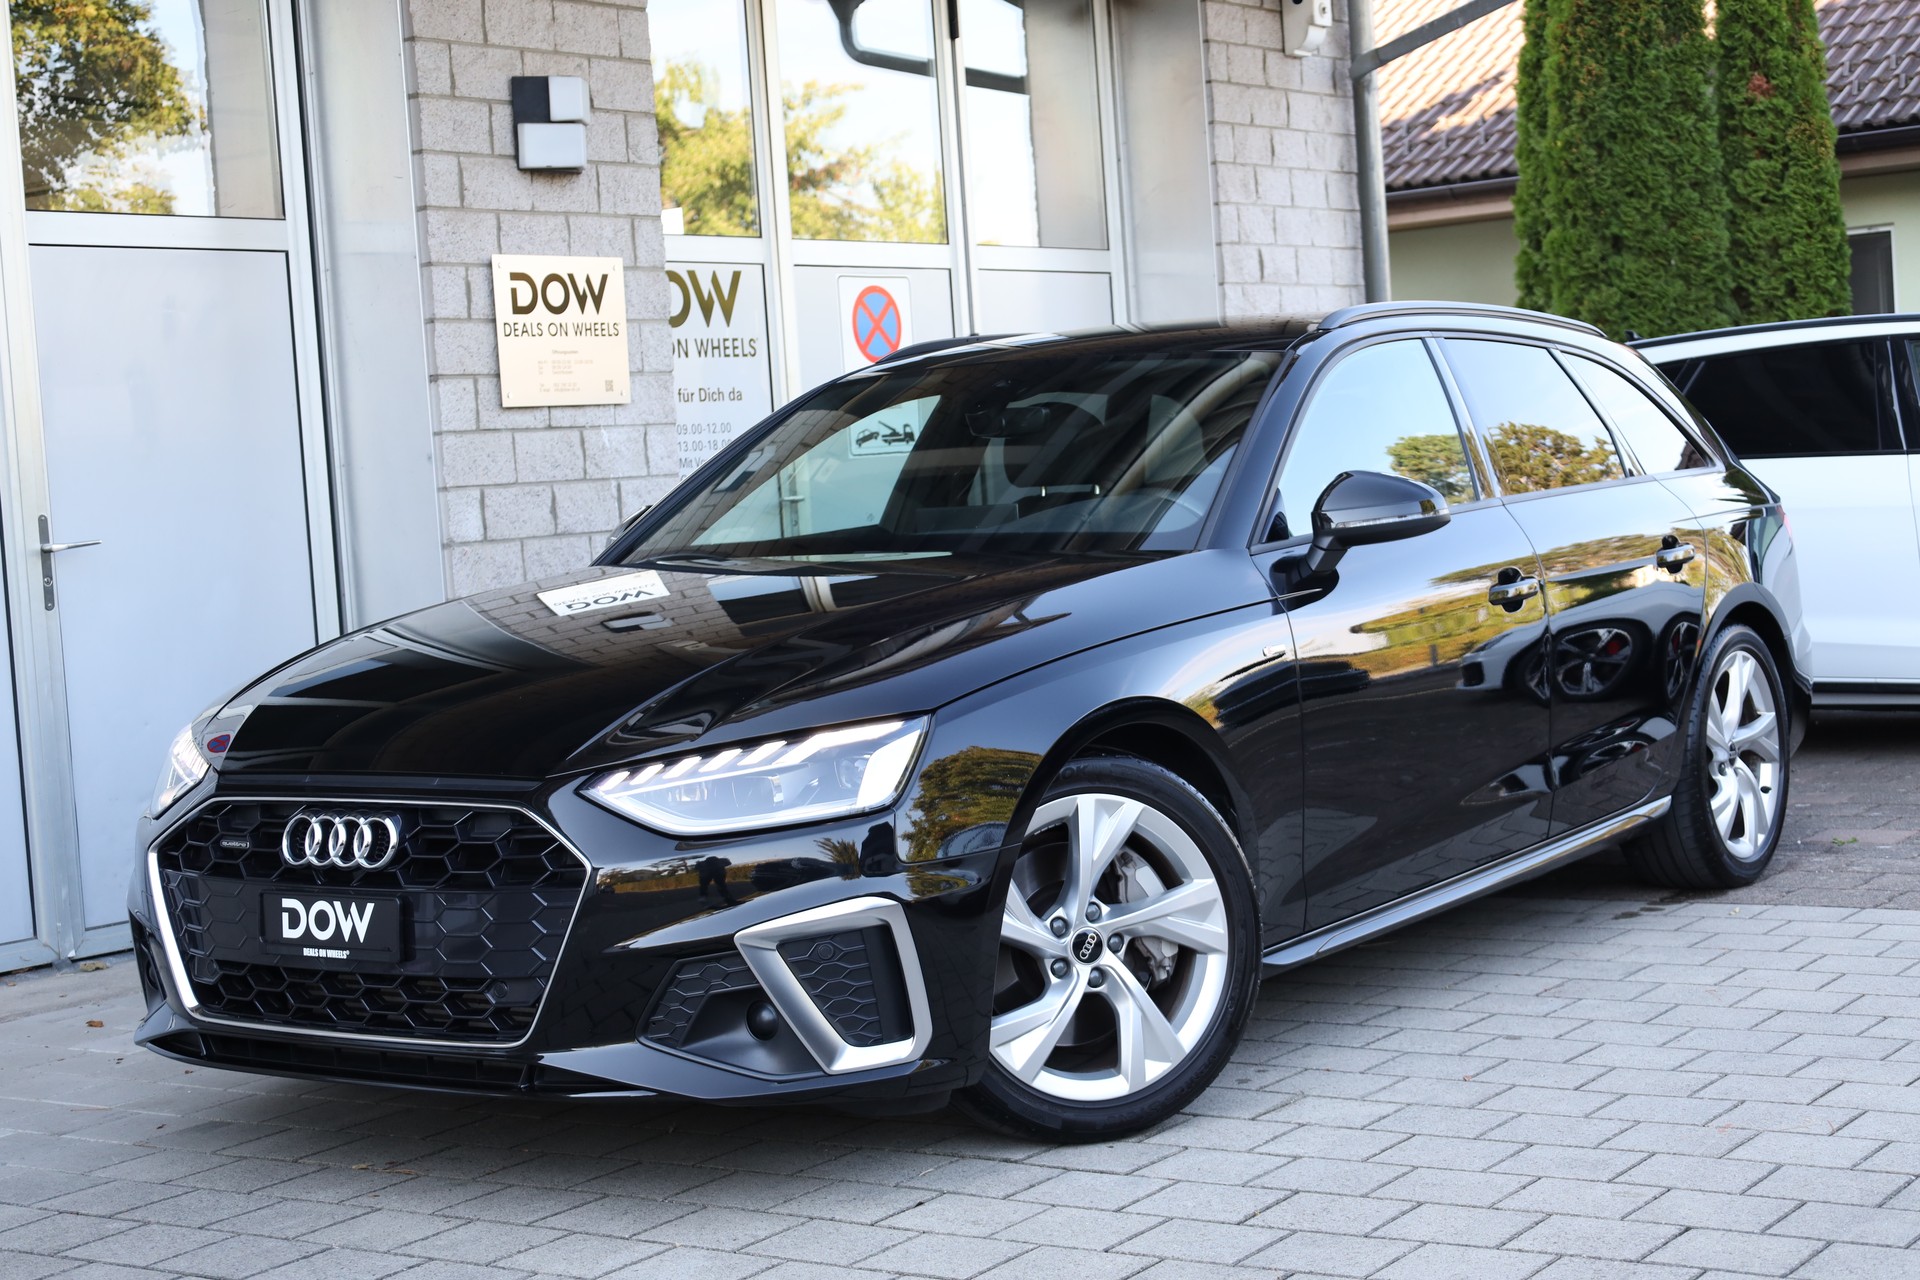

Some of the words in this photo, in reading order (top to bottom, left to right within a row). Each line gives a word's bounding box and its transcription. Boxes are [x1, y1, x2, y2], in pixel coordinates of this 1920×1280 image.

[509, 272, 608, 315] DOW
[503, 322, 543, 337] DEALS
[548, 322, 569, 337] ON
[572, 322, 620, 337] WHEELS
[672, 338, 688, 358] N
[695, 338, 757, 358] WHEELS
[677, 388, 695, 403] für
[699, 387, 725, 402] Dich
[728, 387, 743, 401] da
[676, 422, 731, 435] 09.00-12.00
[282, 898, 375, 943] DOW
[303, 947, 318, 957] DEALS
[319, 948, 326, 957] ON
